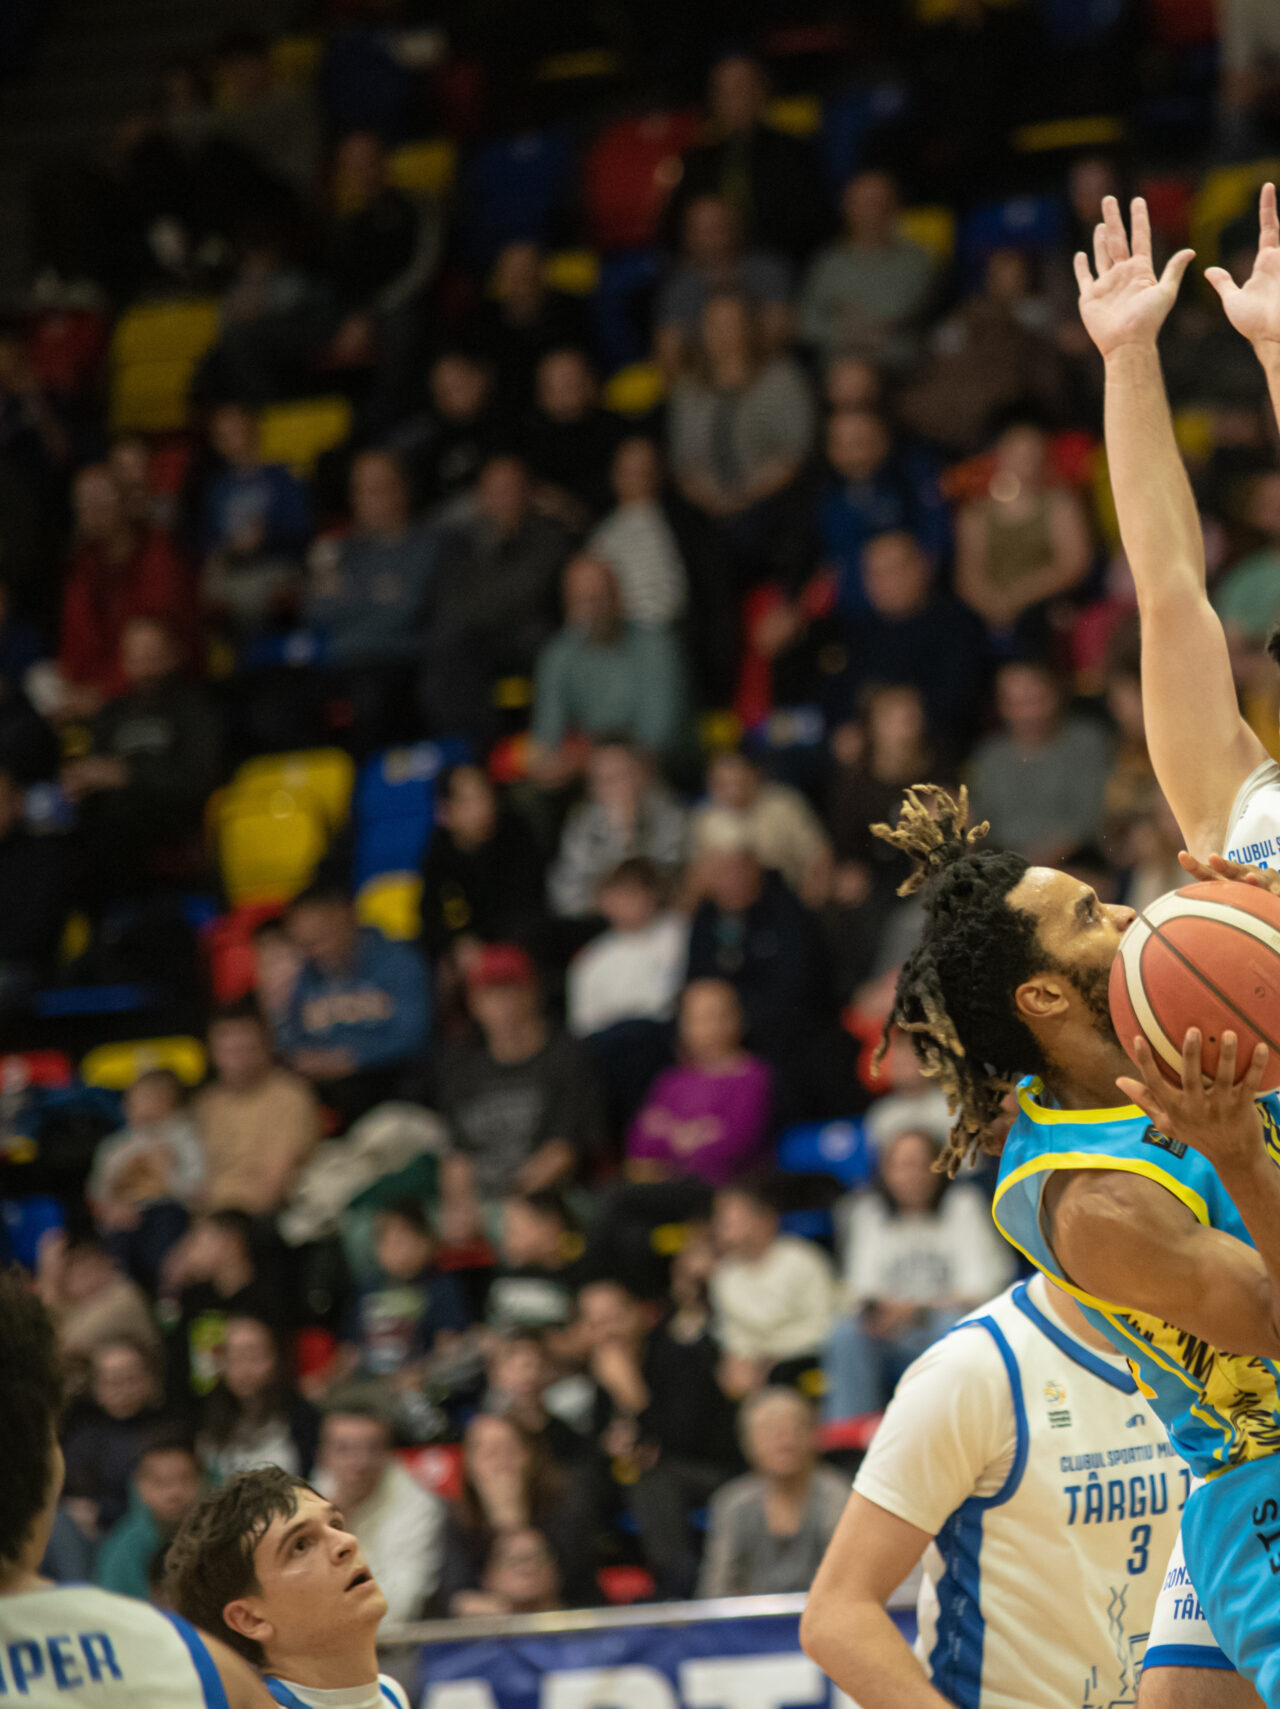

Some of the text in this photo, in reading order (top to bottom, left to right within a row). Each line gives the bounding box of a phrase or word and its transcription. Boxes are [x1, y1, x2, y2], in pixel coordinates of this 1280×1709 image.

[1228, 839, 1277, 865] CLUBUL
[1059, 1452, 1106, 1473] CLUBUL
[1063, 1470, 1168, 1526] TÂRGU
[1126, 1523, 1152, 1576] 3
[0, 1630, 123, 1695] PER
